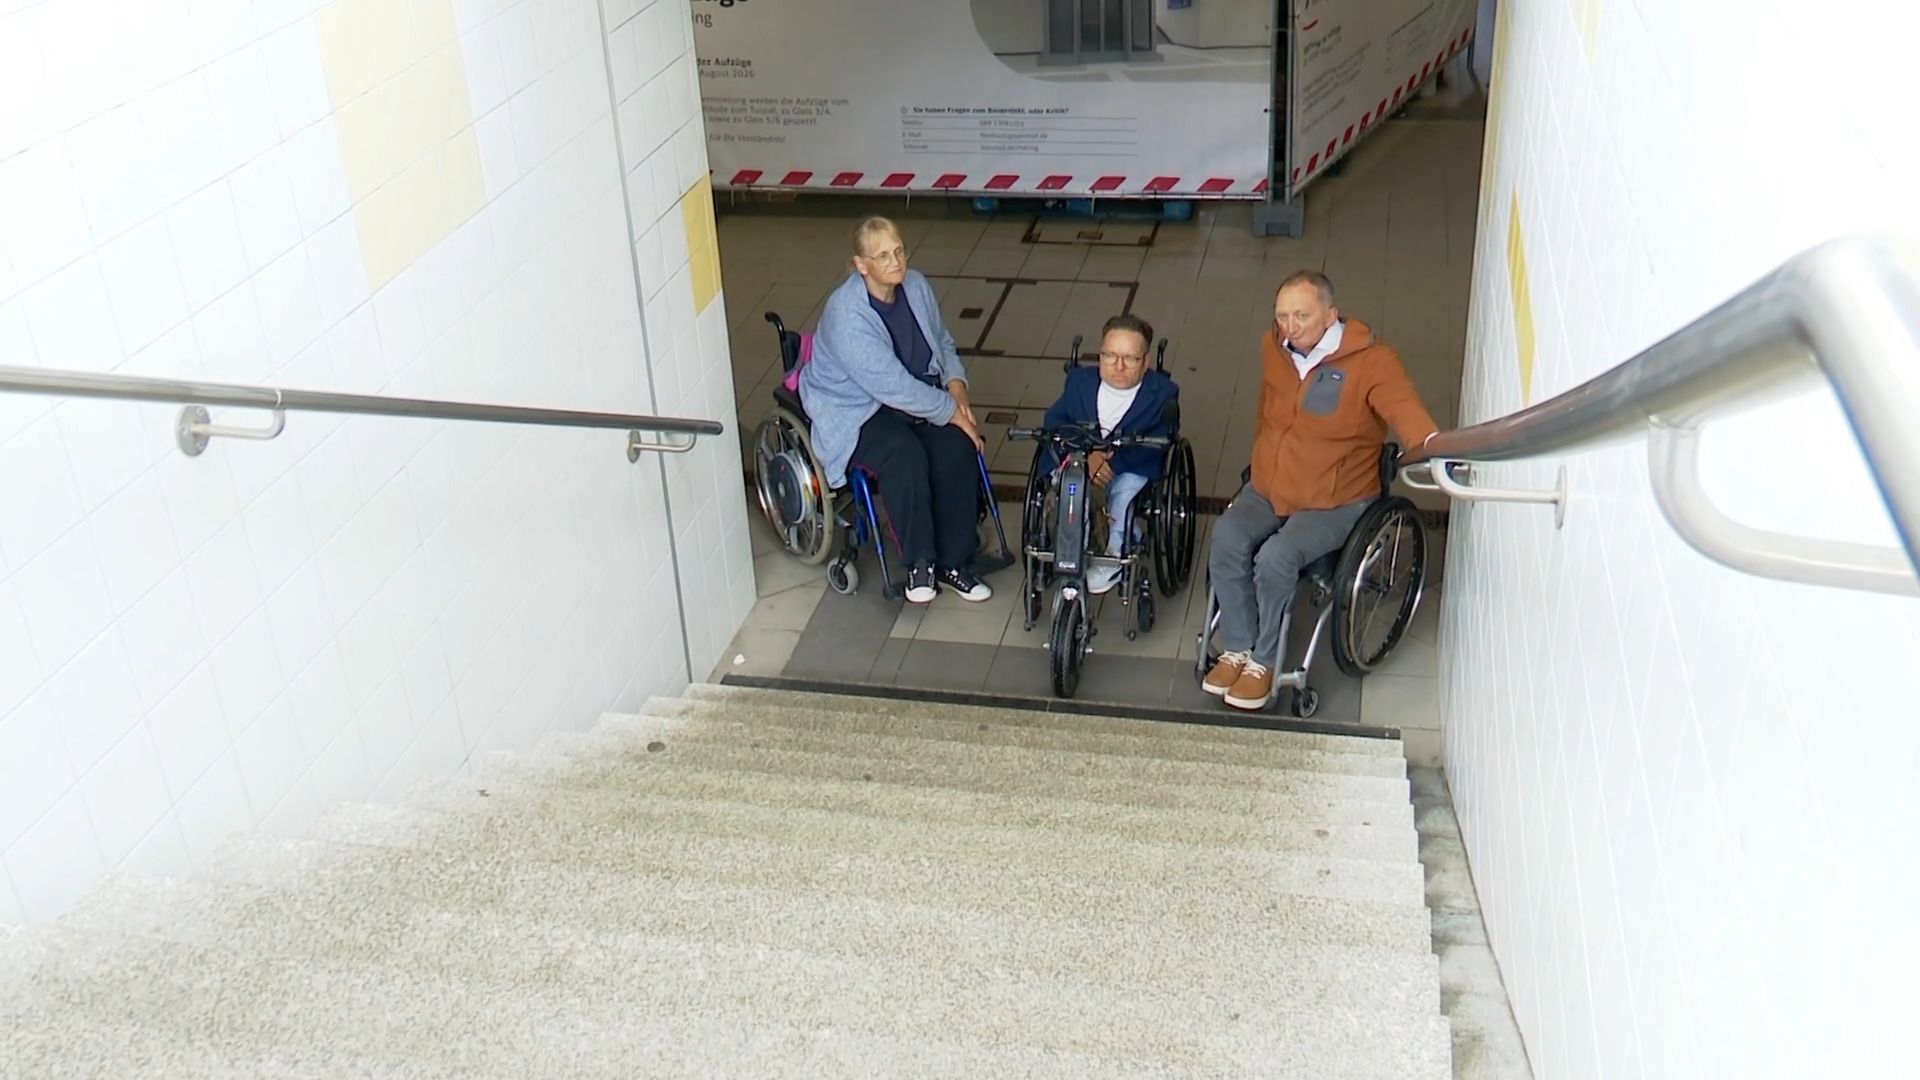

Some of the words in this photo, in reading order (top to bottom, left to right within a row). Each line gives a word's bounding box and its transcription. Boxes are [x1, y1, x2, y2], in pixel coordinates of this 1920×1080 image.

[714, 57, 752, 69] Aufzüge
[700, 69, 729, 79] August
[796, 97, 829, 108] Aufzüge
